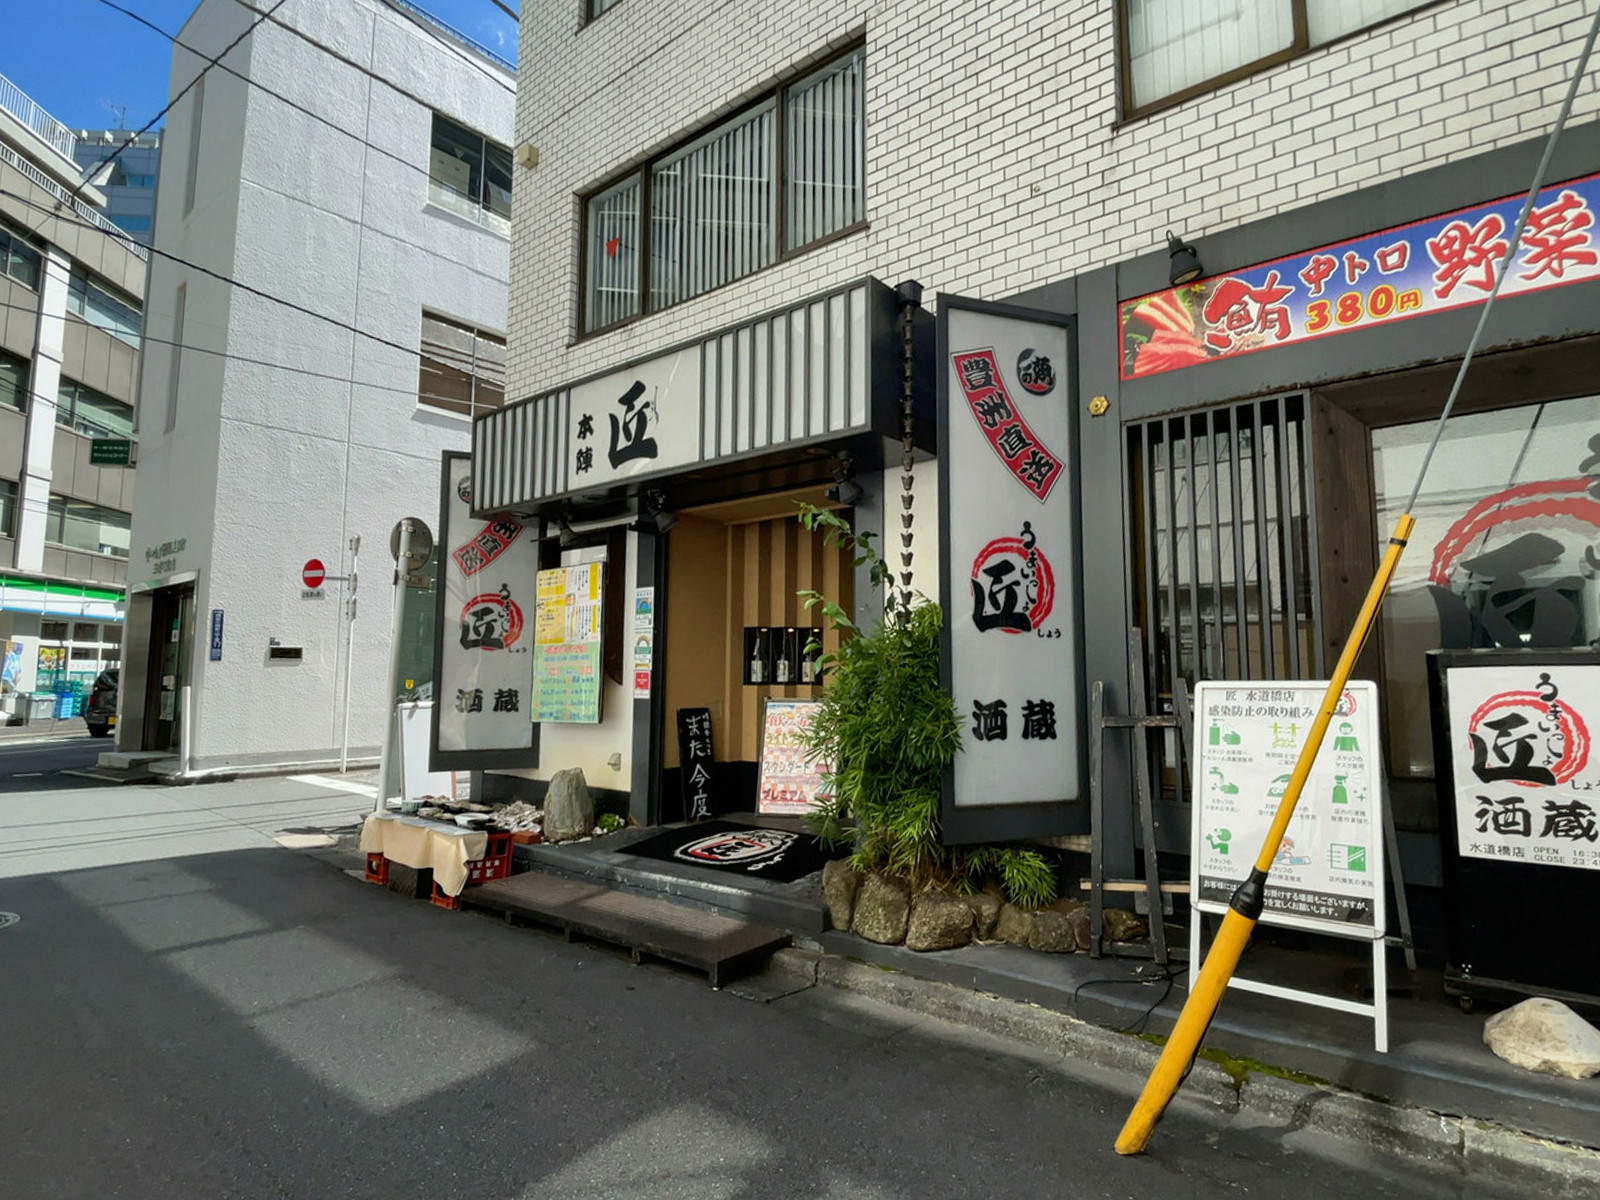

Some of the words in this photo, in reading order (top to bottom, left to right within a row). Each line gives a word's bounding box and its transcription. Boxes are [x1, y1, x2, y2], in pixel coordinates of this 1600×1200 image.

[1425, 193, 1598, 299] 野菜
[1299, 243, 1410, 295] 中トロ
[1305, 285, 1421, 333] 380円
[576, 413, 594, 475] 本陣
[608, 380, 658, 470] 匠
[970, 559, 1033, 633] 匠
[459, 607, 505, 650] 匠
[1037, 628, 1062, 639] しょう
[456, 688, 520, 713] 酒蔵
[1208, 705, 1315, 719] 感染防止の取り組み
[1245, 689, 1296, 702] 水道橋店
[971, 699, 1058, 741] 酒蔵
[685, 714, 713, 822] また今度
[1336, 755, 1363, 763] スタッフの
[1469, 712, 1558, 786] 匠
[1474, 795, 1600, 843] 酒蔵
[1469, 842, 1526, 858] 水道橋店
[1533, 846, 1560, 856] OPEN
[1534, 854, 1566, 864] CLOSE
